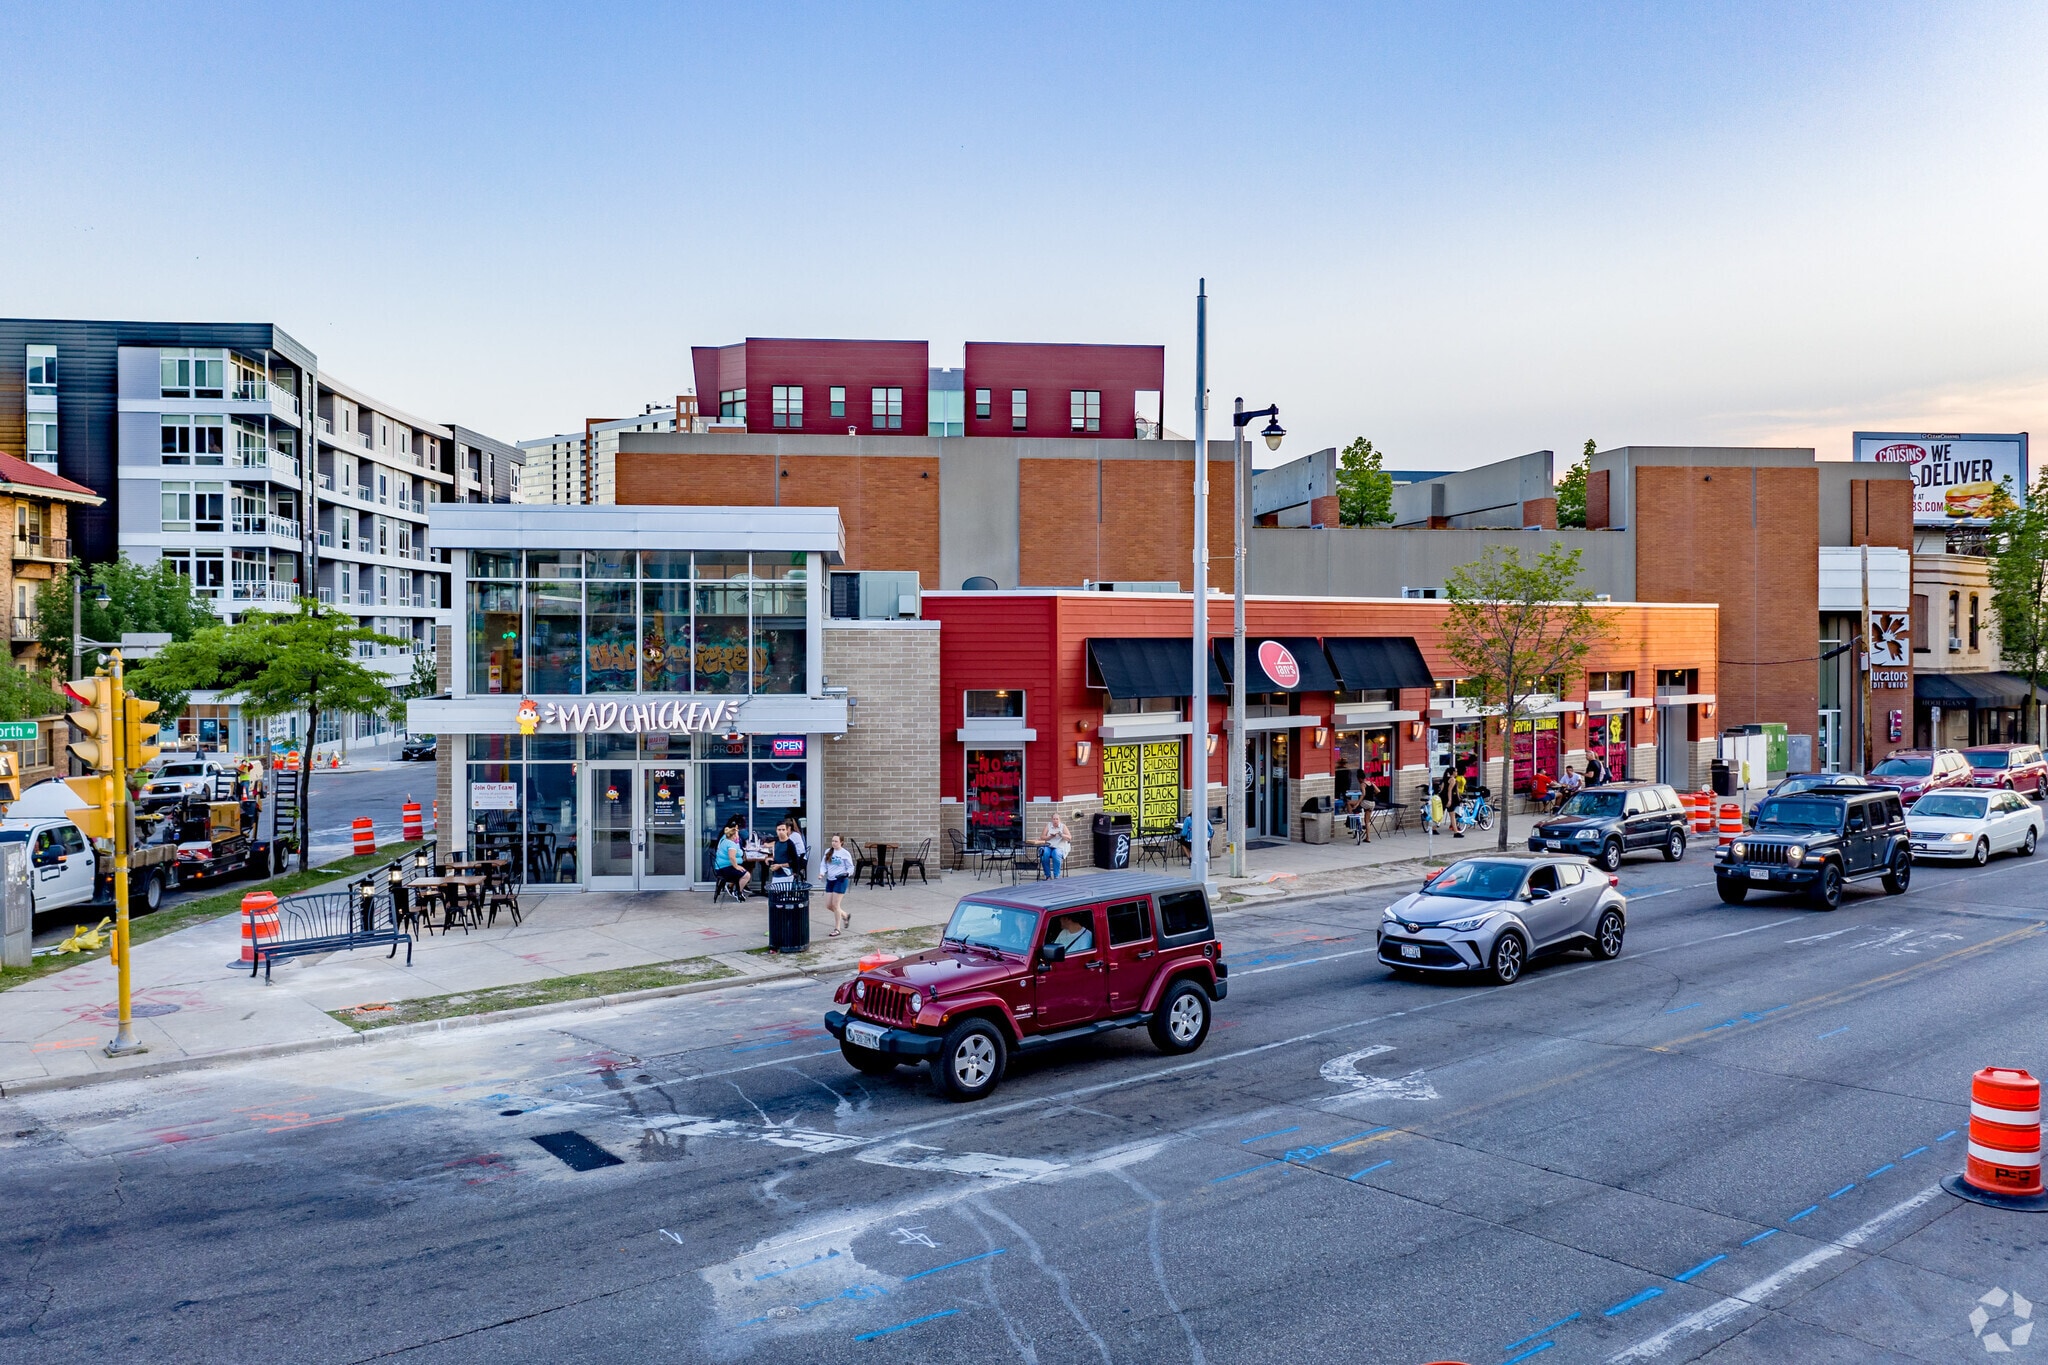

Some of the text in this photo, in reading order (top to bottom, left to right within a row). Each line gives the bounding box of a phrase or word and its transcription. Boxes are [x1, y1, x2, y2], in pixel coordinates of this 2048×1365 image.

[1931, 444, 1952, 462] WE
[1921, 459, 1993, 488] DELIVER
[558, 699, 727, 735] MAD CHICKEN
[203, 721, 215, 729] 5G
[775, 741, 803, 750] OPEN
[1143, 744, 1177, 757] BLACK
[1103, 746, 1136, 760] BLACK
[979, 756, 1001, 772] NO
[1103, 759, 1136, 775] LIVES
[1143, 758, 1177, 771] CHILDREN
[655, 770, 676, 778] 2045
[970, 771, 1020, 788] JUSTICE
[1143, 771, 1177, 786] MATTER
[1103, 775, 1137, 790] MATTER
[980, 792, 1000, 806] NO
[1103, 792, 1136, 806] BLACK
[1144, 787, 1175, 800] BLACK
[1144, 802, 1177, 815] FUTURES
[971, 810, 1013, 827] PEACE
[1144, 816, 1176, 829] MATTER
